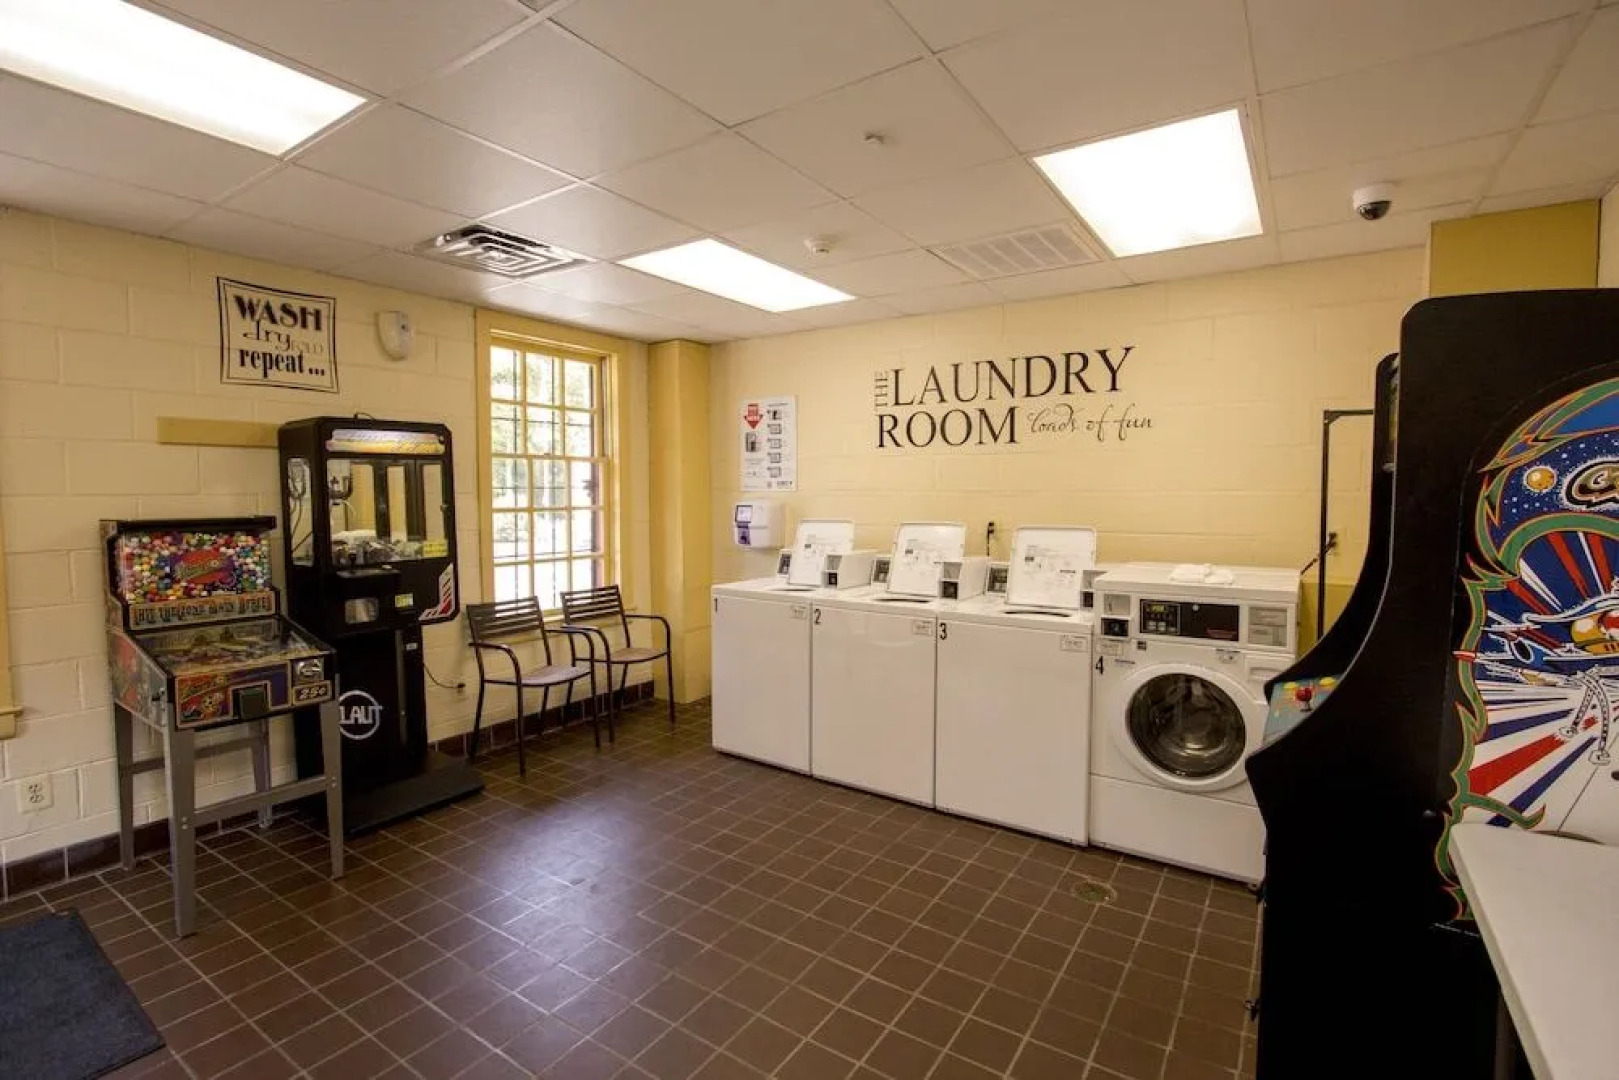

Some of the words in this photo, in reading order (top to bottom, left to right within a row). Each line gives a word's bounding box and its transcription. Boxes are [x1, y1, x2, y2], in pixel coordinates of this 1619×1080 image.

[233, 295, 322, 331] WASH
[243, 319, 291, 351] dry
[874, 371, 889, 410] THE
[891, 346, 1135, 406] LAUNDRY
[876, 406, 1020, 448] ROOM
[1086, 404, 1114, 442] of
[1113, 403, 1152, 441] fun
[713, 597, 719, 613] 1
[813, 607, 822, 626] 2
[938, 622, 948, 641] 3
[1095, 655, 1104, 675] 4
